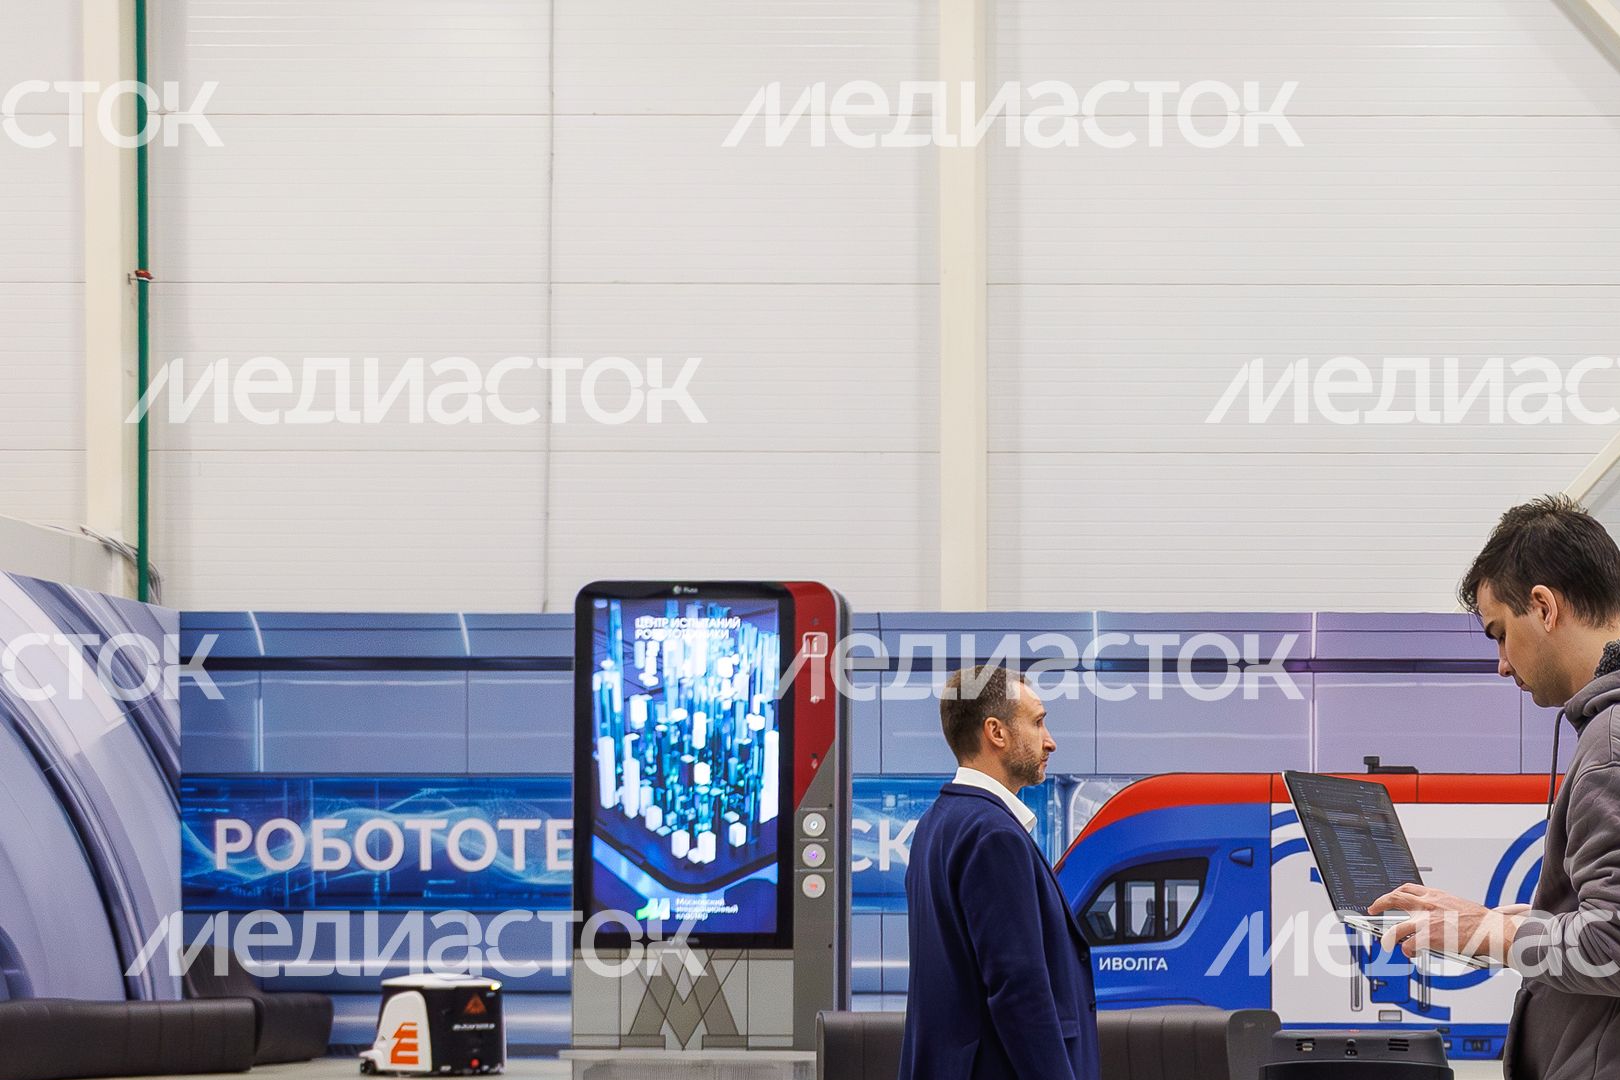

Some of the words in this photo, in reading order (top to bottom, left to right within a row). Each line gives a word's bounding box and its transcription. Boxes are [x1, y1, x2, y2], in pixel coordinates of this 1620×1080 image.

[215, 818, 574, 872] РОБОТОТЕ
[851, 818, 918, 872] СК
[1099, 957, 1168, 971] ИВОЛГА
